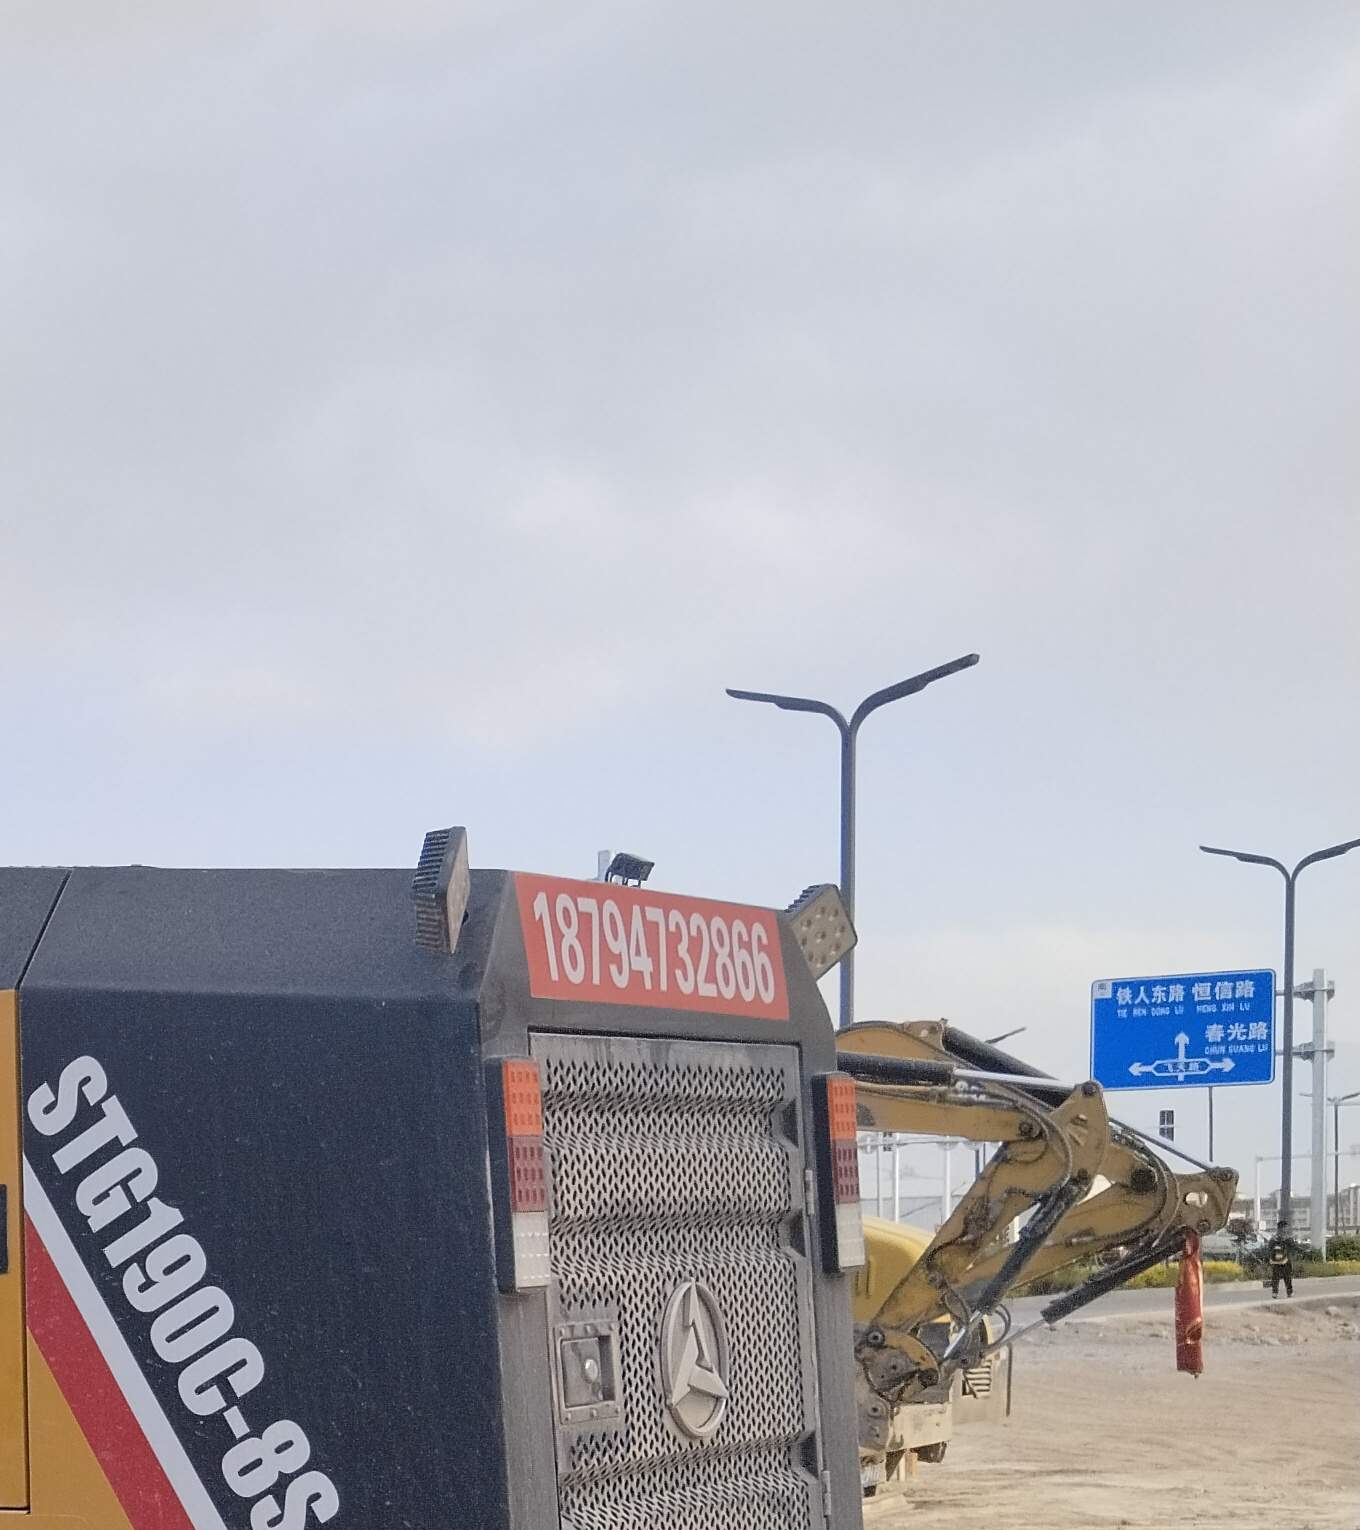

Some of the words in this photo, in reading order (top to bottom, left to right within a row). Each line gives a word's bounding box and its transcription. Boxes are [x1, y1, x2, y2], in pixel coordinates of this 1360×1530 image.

[533, 892, 775, 1004] 18794732866
[1116, 984, 1185, 1005] 铁人东路
[1191, 980, 1255, 1001] 恒信路
[1205, 1021, 1268, 1042] 春光路
